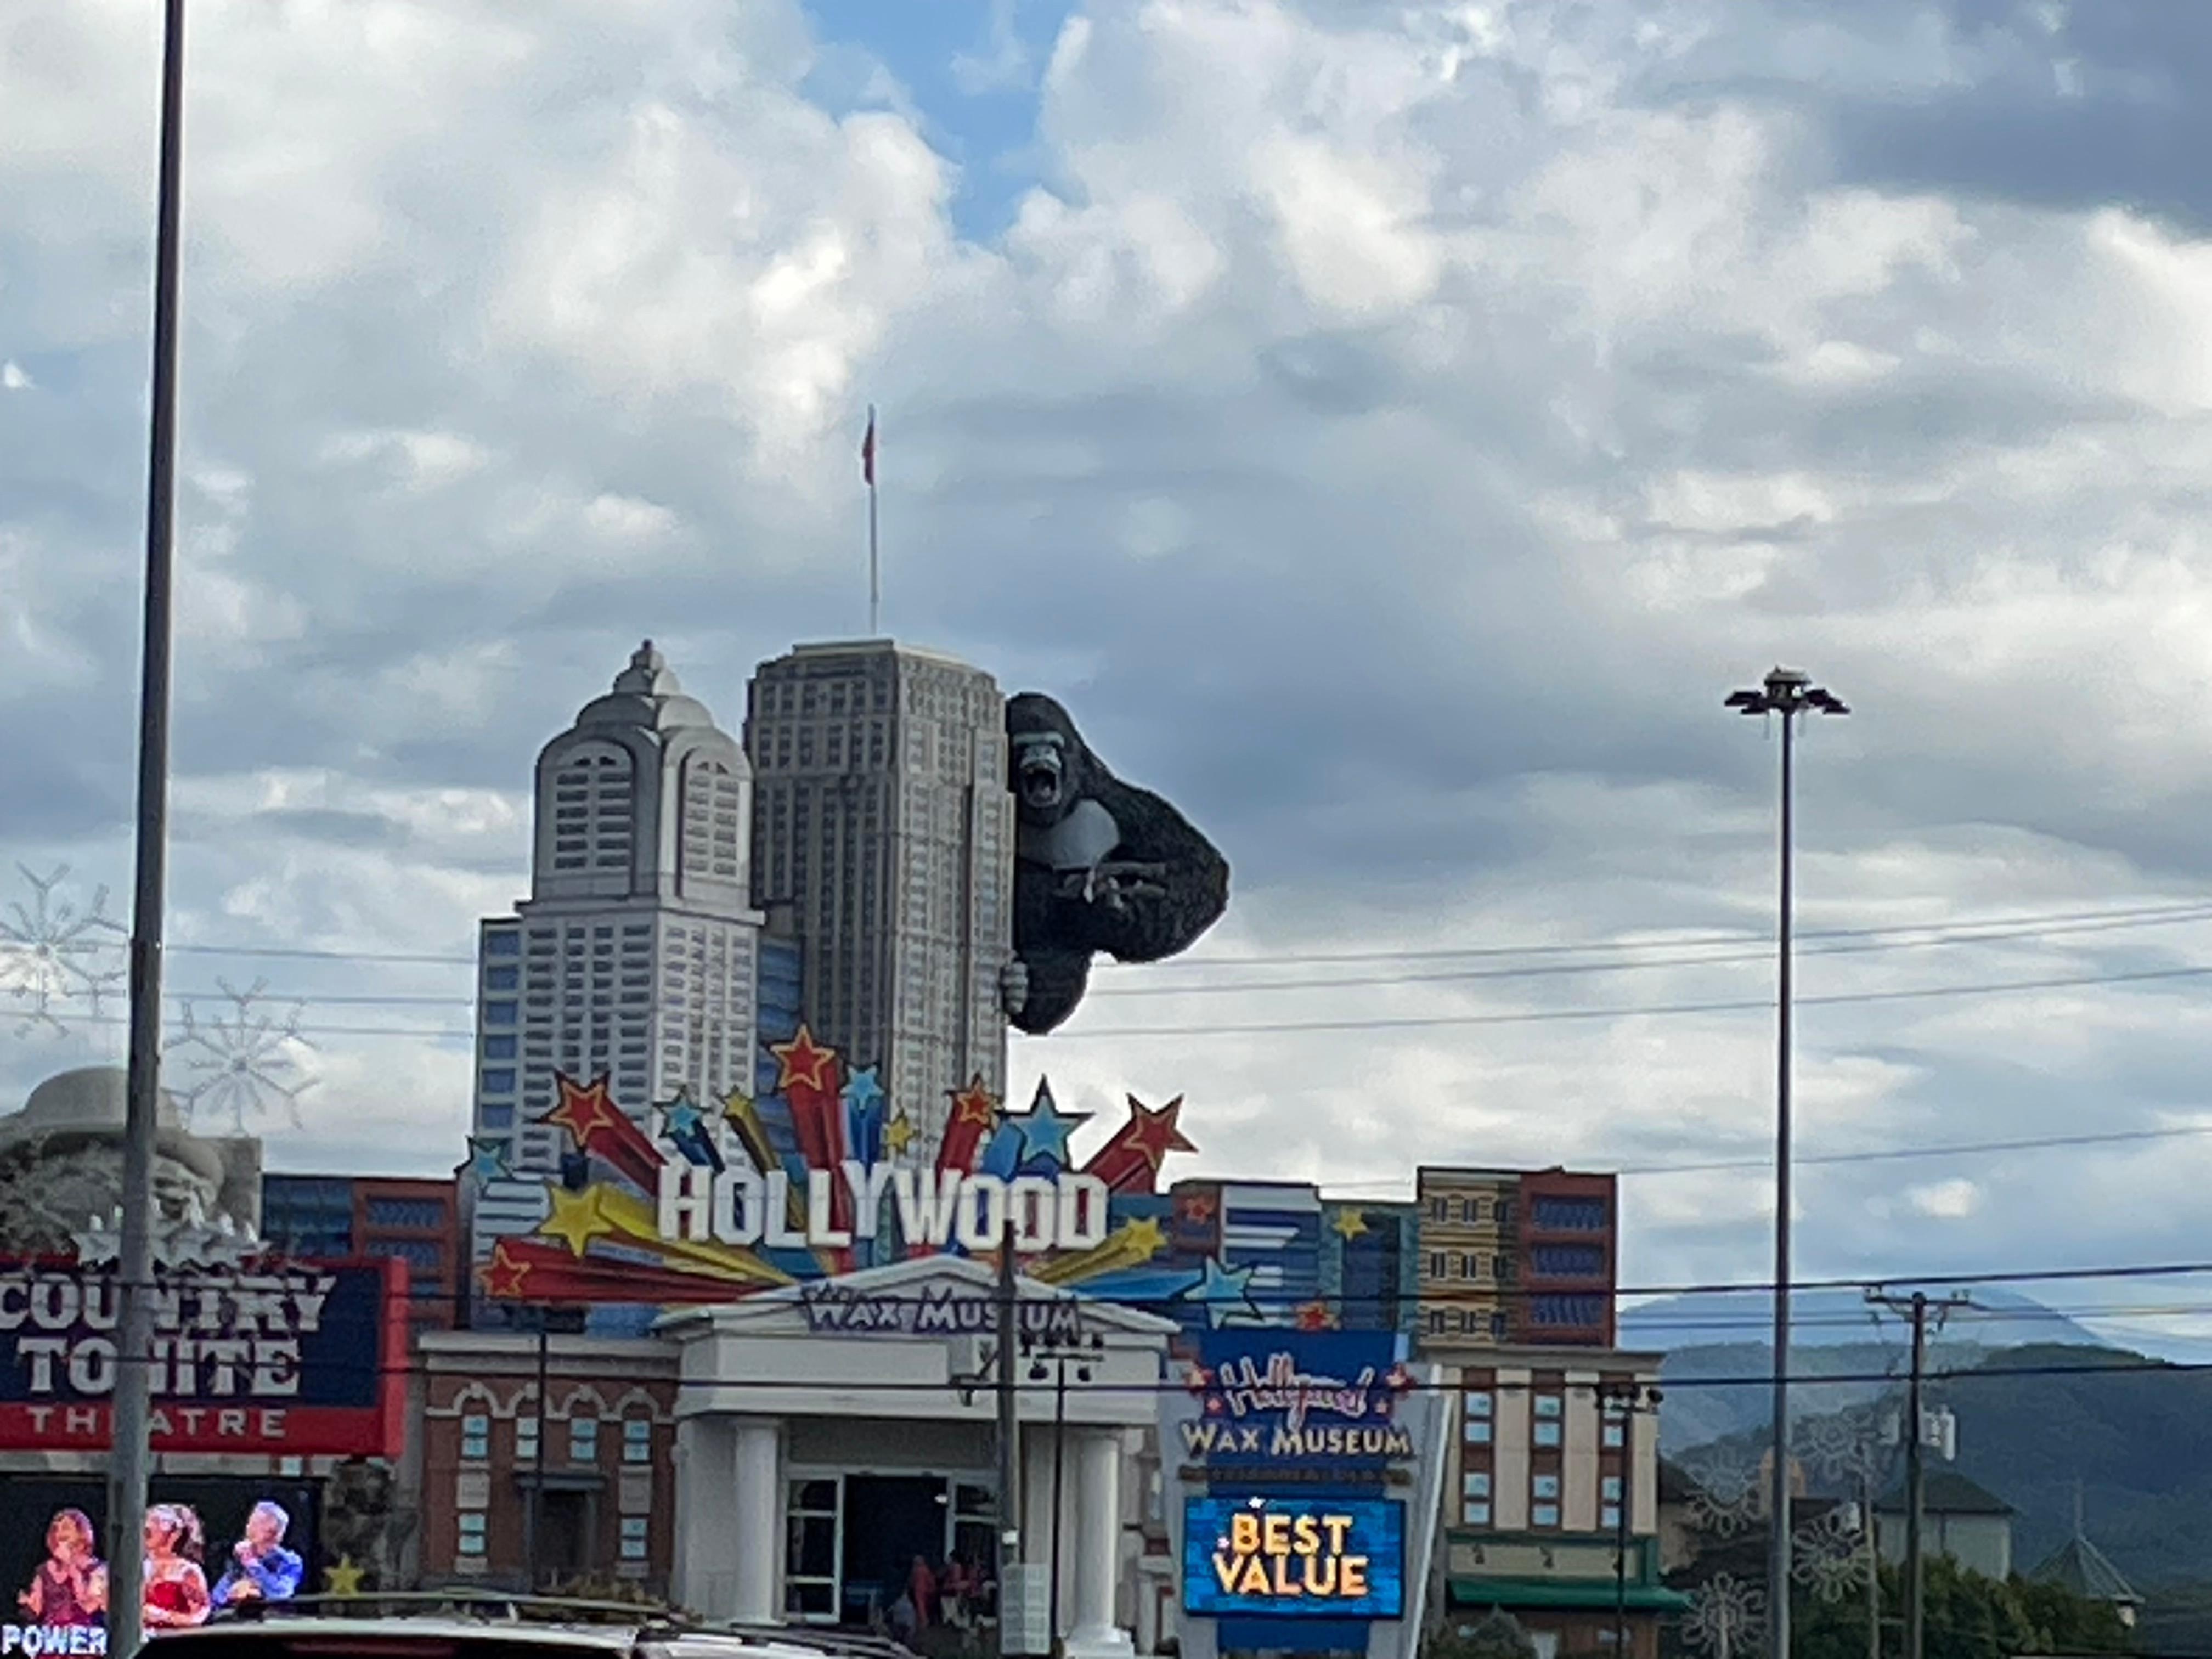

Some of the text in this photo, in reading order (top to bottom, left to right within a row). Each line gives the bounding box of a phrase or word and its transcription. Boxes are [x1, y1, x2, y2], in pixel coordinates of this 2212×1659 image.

[659, 1161, 1108, 1252] HOLLYWOOD
[803, 1285, 1079, 1331] WAX MUSUM
[27, 1406, 287, 1438] THATRE
[1181, 1423, 1410, 1455] WAX MUSEUM
[1231, 1513, 1353, 1556] BEST
[1212, 1551, 1370, 1597] VALUE
[2, 1624, 108, 1655] POWER
